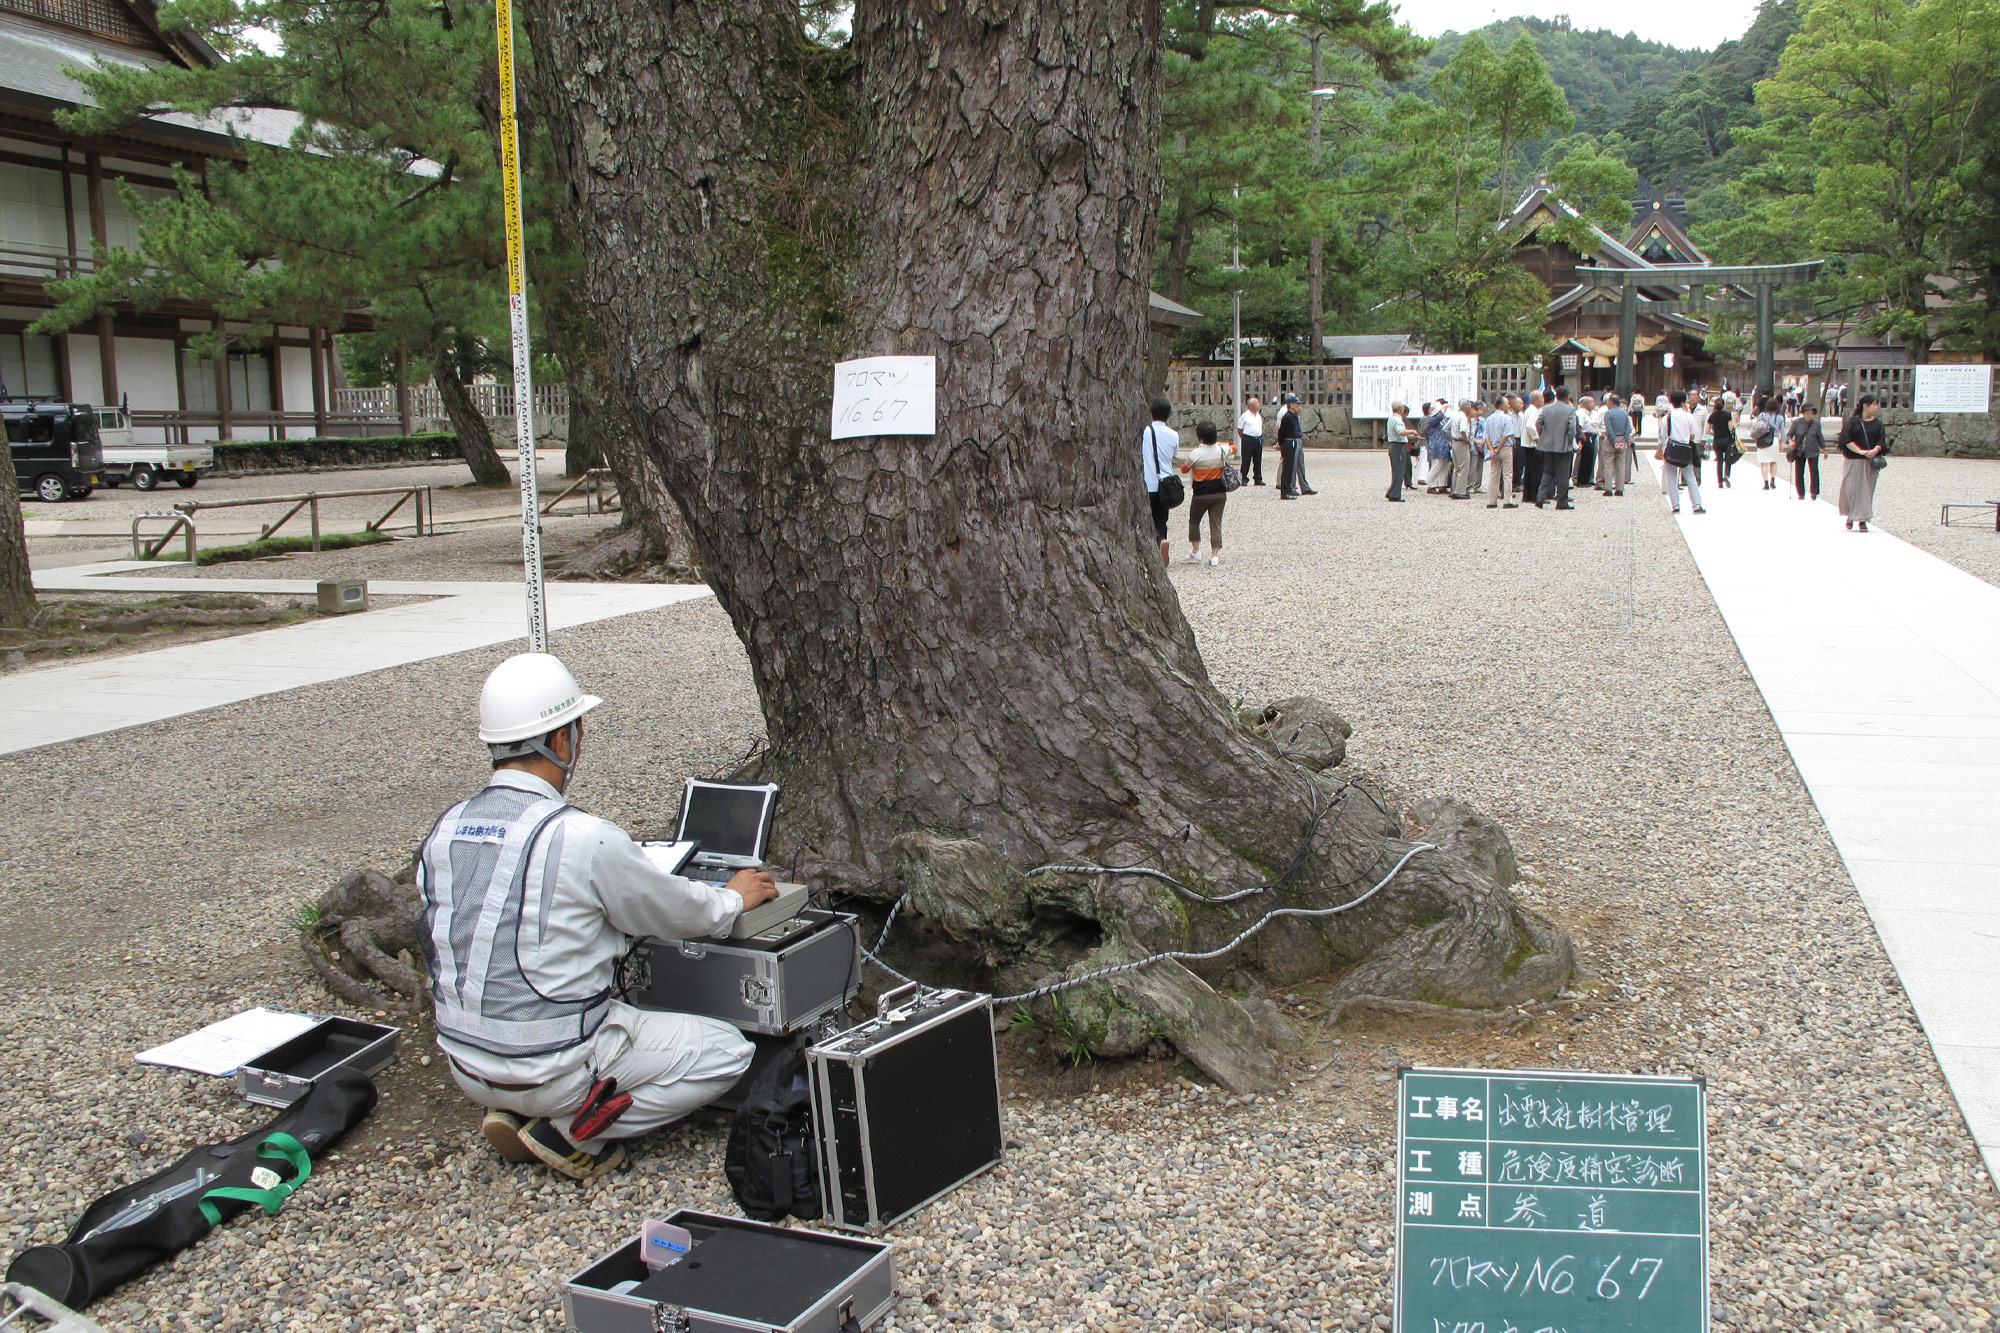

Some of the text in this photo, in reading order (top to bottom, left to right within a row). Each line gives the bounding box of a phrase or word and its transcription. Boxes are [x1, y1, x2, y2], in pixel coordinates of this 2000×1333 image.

[847, 370, 909, 387] クロマツ
[872, 398, 908, 421] 67
[455, 825, 506, 838] しまね樹木医会
[1409, 1096, 1483, 1121] 工事名
[1498, 1149, 1684, 1186] 危険度精密診断
[1597, 1254, 1663, 1299] 67
